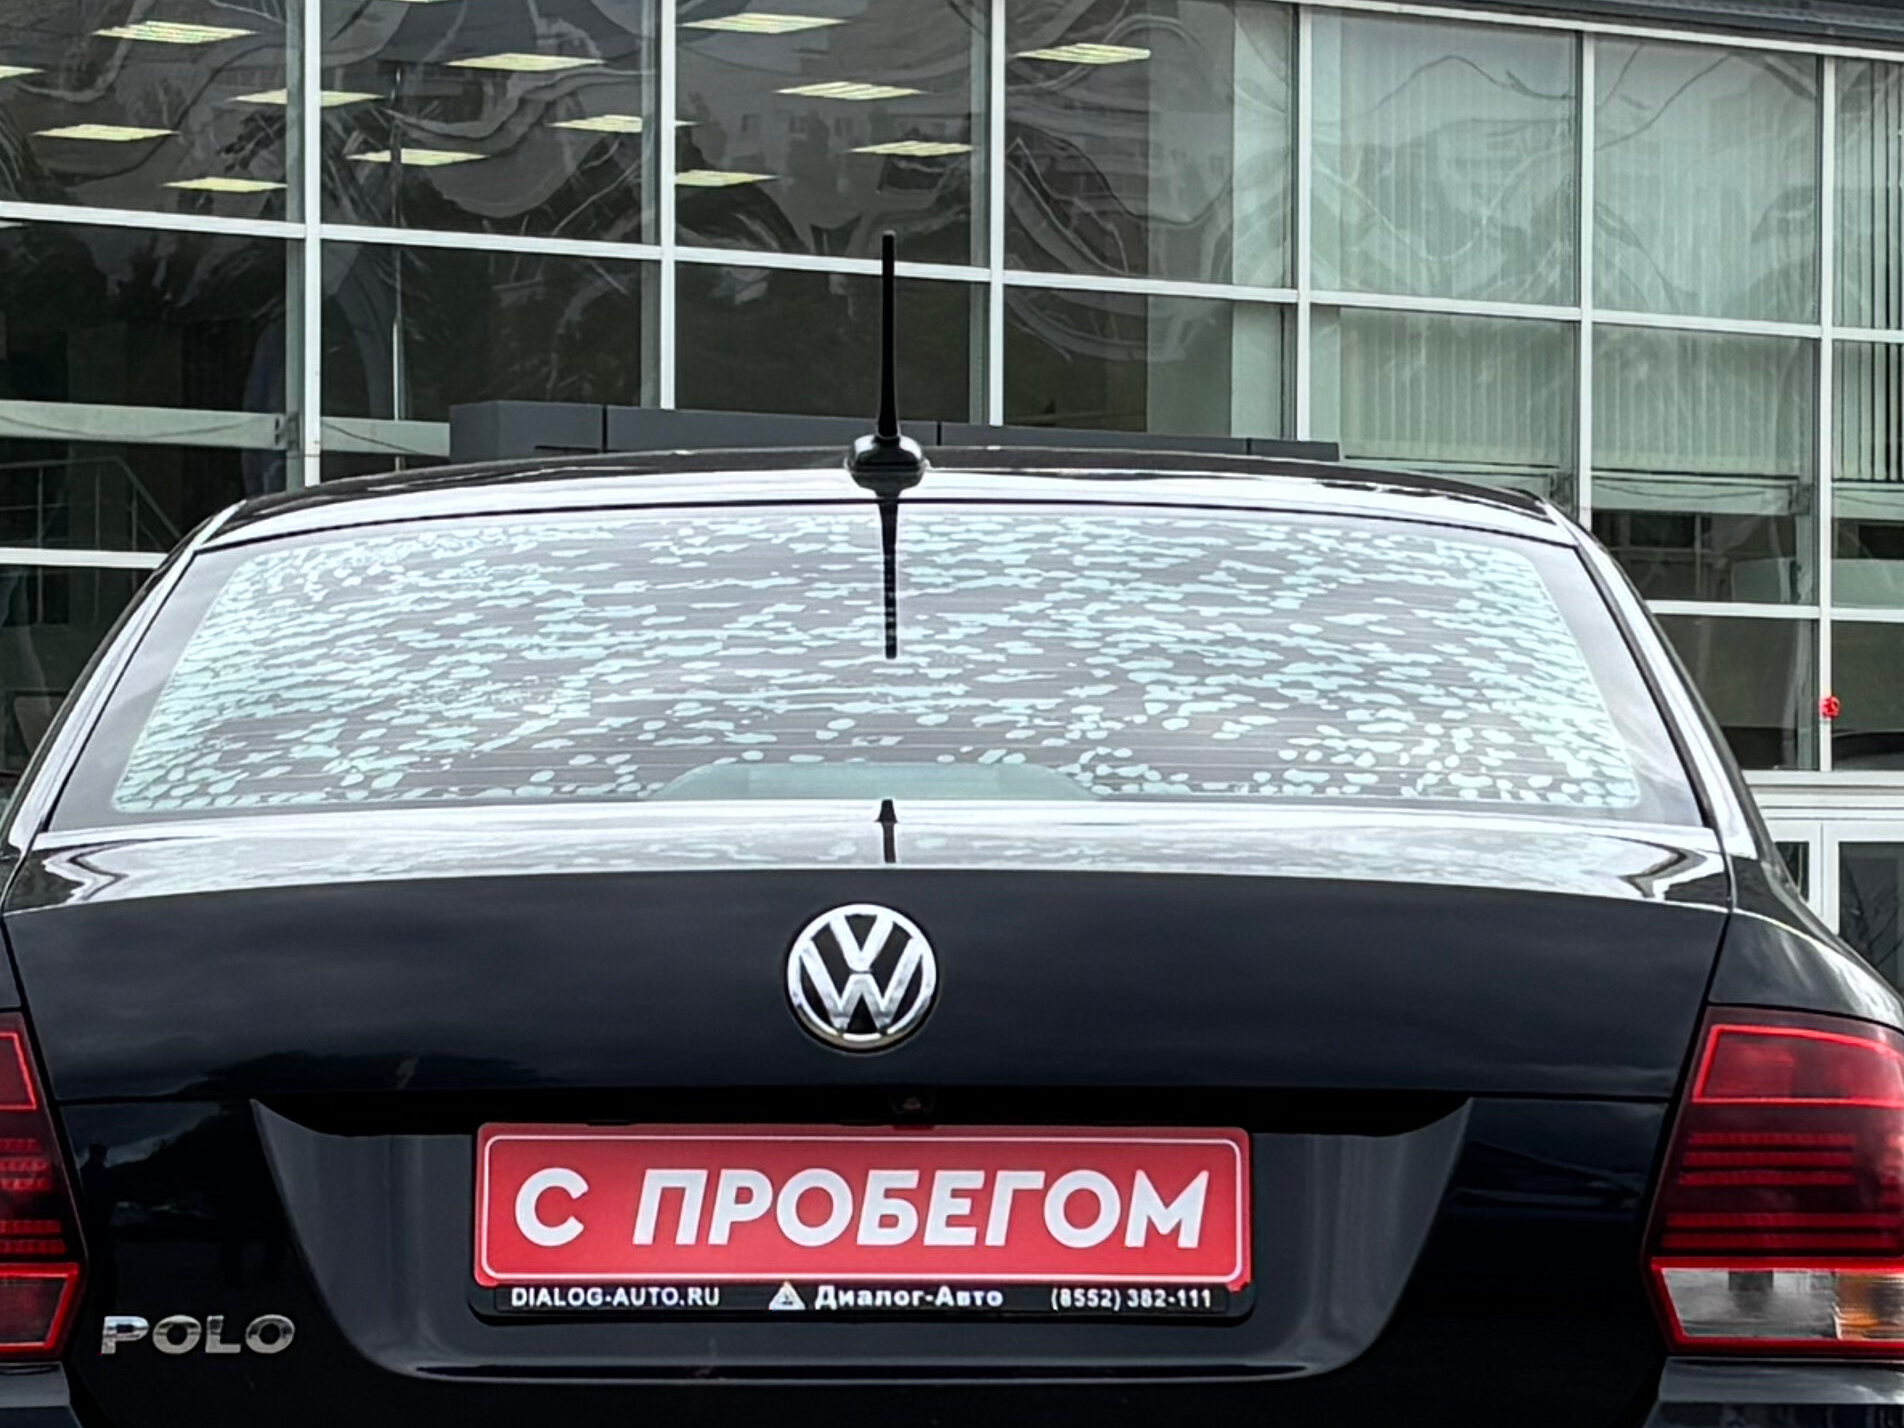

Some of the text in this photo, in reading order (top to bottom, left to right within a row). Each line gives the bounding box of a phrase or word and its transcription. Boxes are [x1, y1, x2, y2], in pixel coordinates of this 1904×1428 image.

[514, 1167, 1211, 1249] С ПРОБЕГОМ
[510, 1285, 721, 1308] DIALOG-AUTO.RU
[814, 1284, 1005, 1311] Диалог-Авто
[1050, 1288, 1213, 1312] (8552) 382-111
[100, 1314, 295, 1355] POLO
